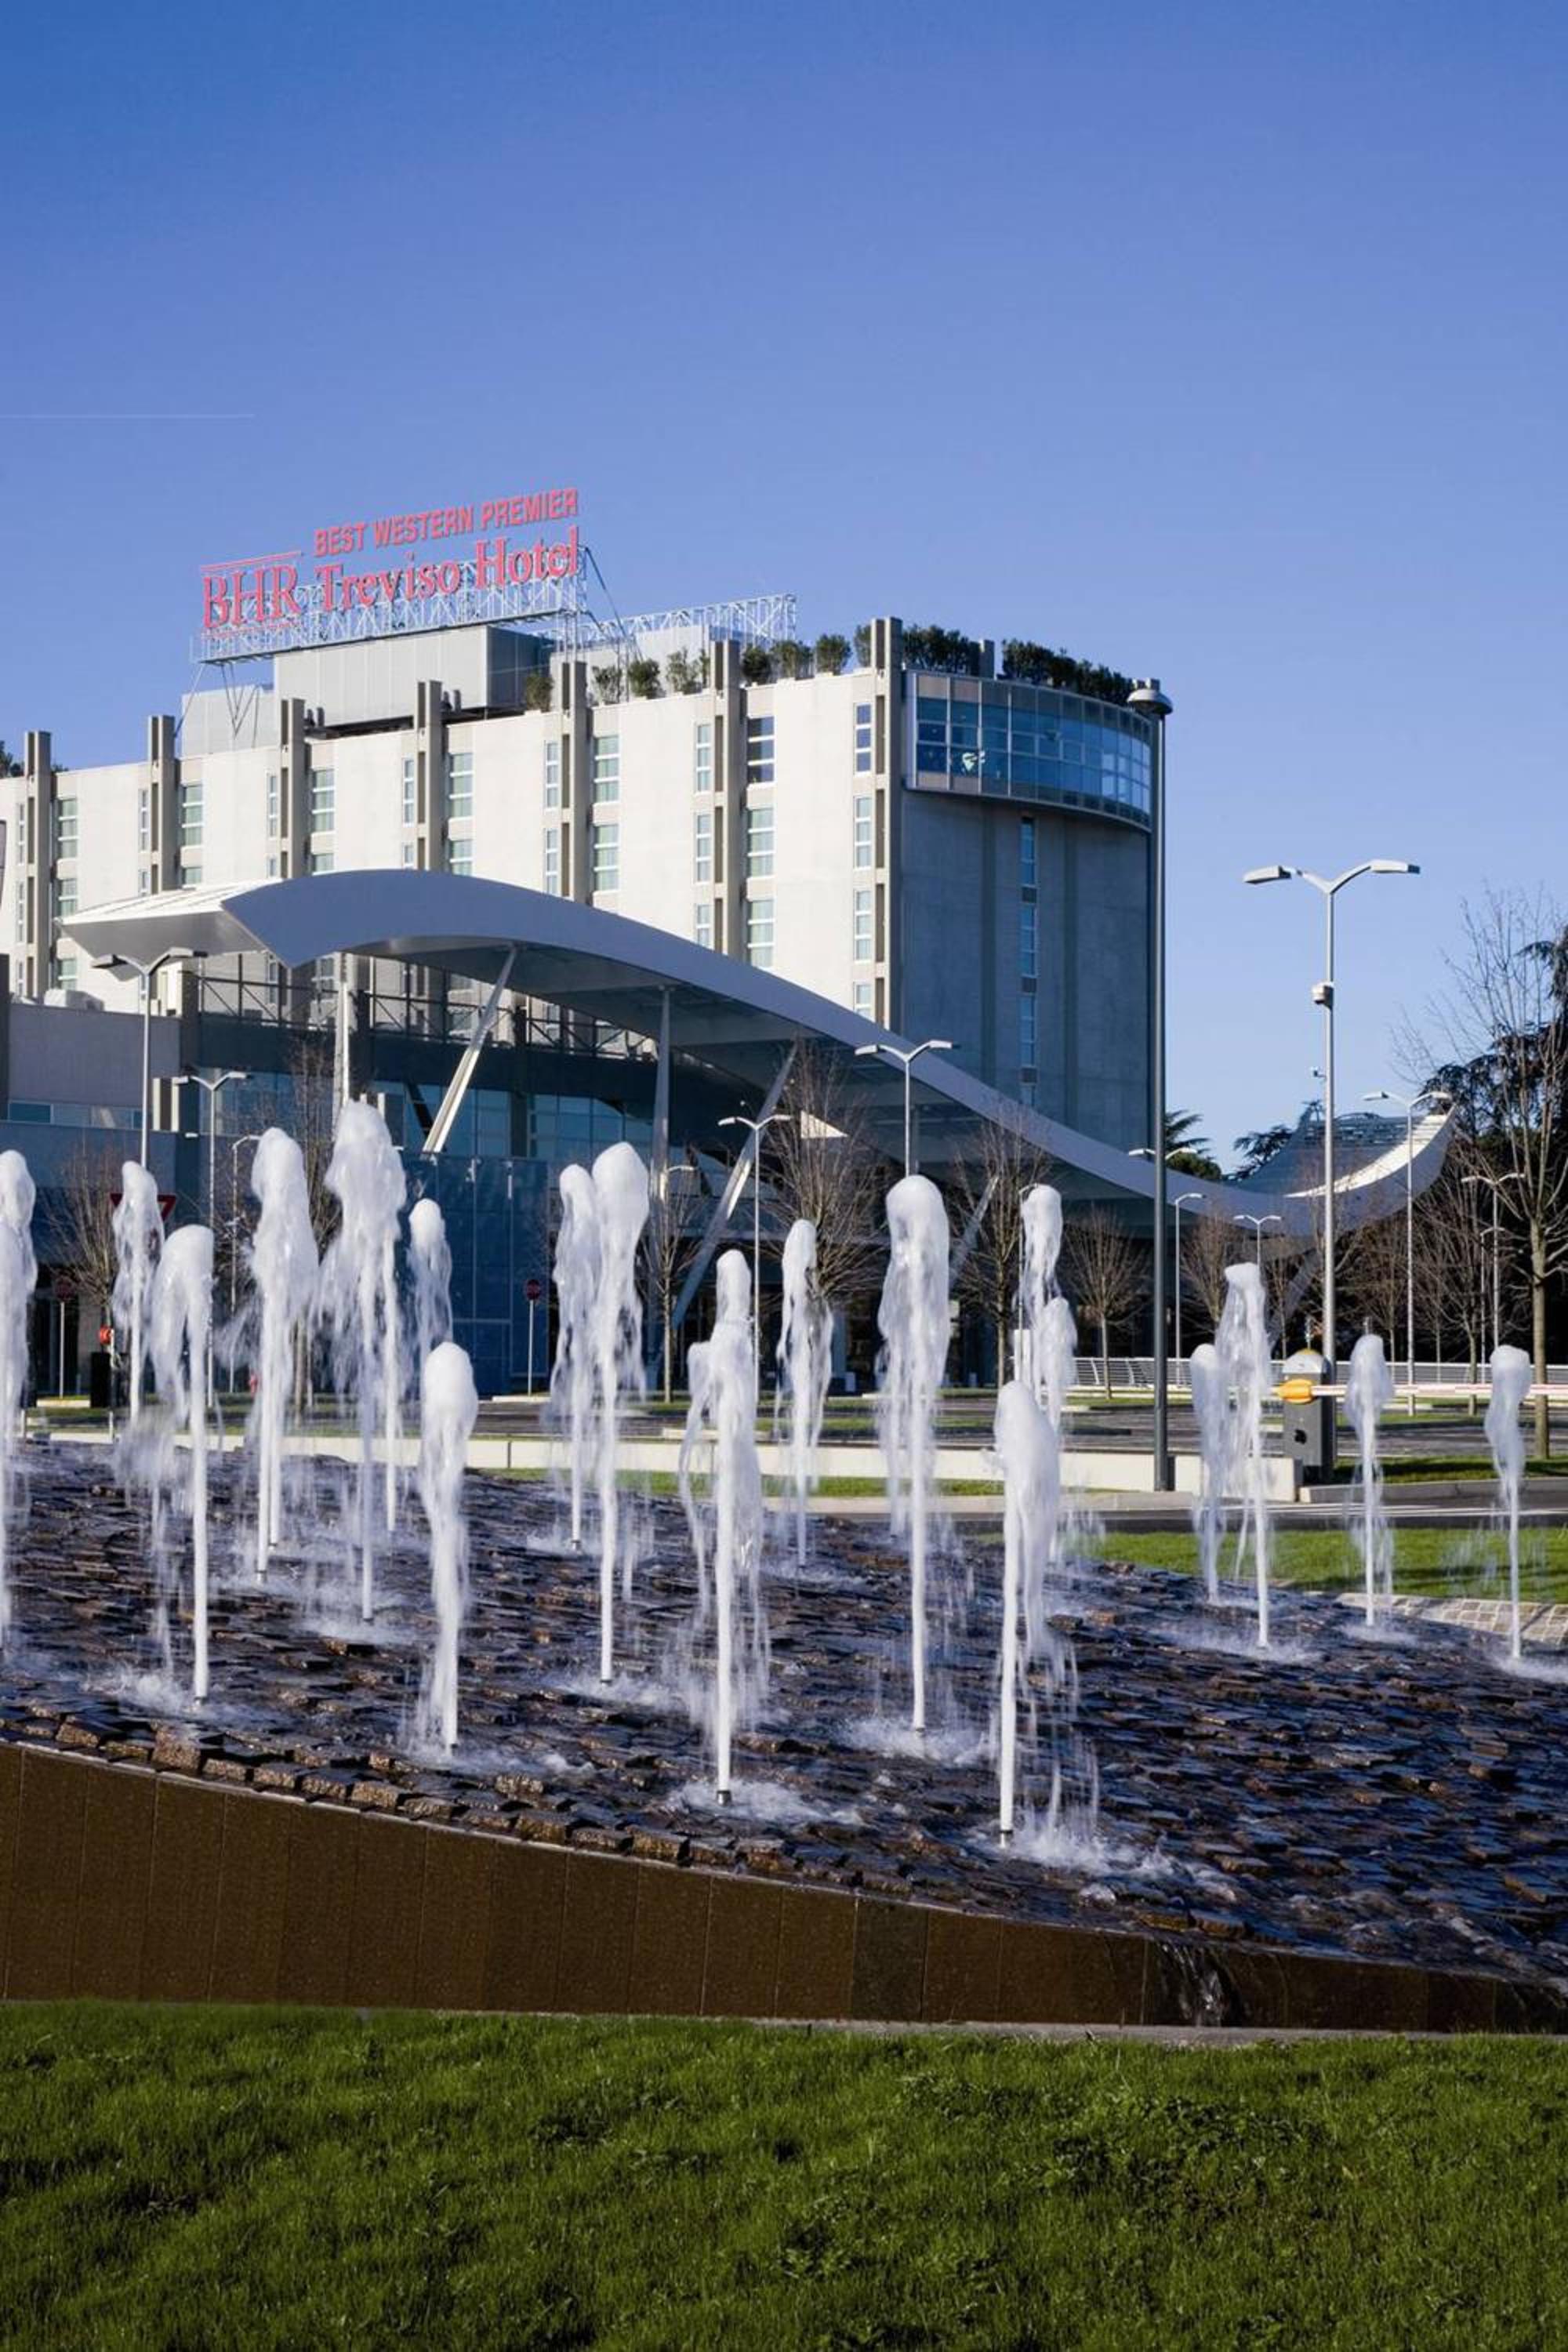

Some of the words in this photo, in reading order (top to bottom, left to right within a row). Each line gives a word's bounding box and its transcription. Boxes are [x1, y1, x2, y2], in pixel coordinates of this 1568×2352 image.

[314, 521, 368, 557] BEST
[372, 506, 474, 547] WESTERN
[480, 488, 578, 529] PREMIER
[201, 564, 302, 628] BHR
[314, 551, 461, 612] Treviso
[475, 524, 579, 588] Hotel
